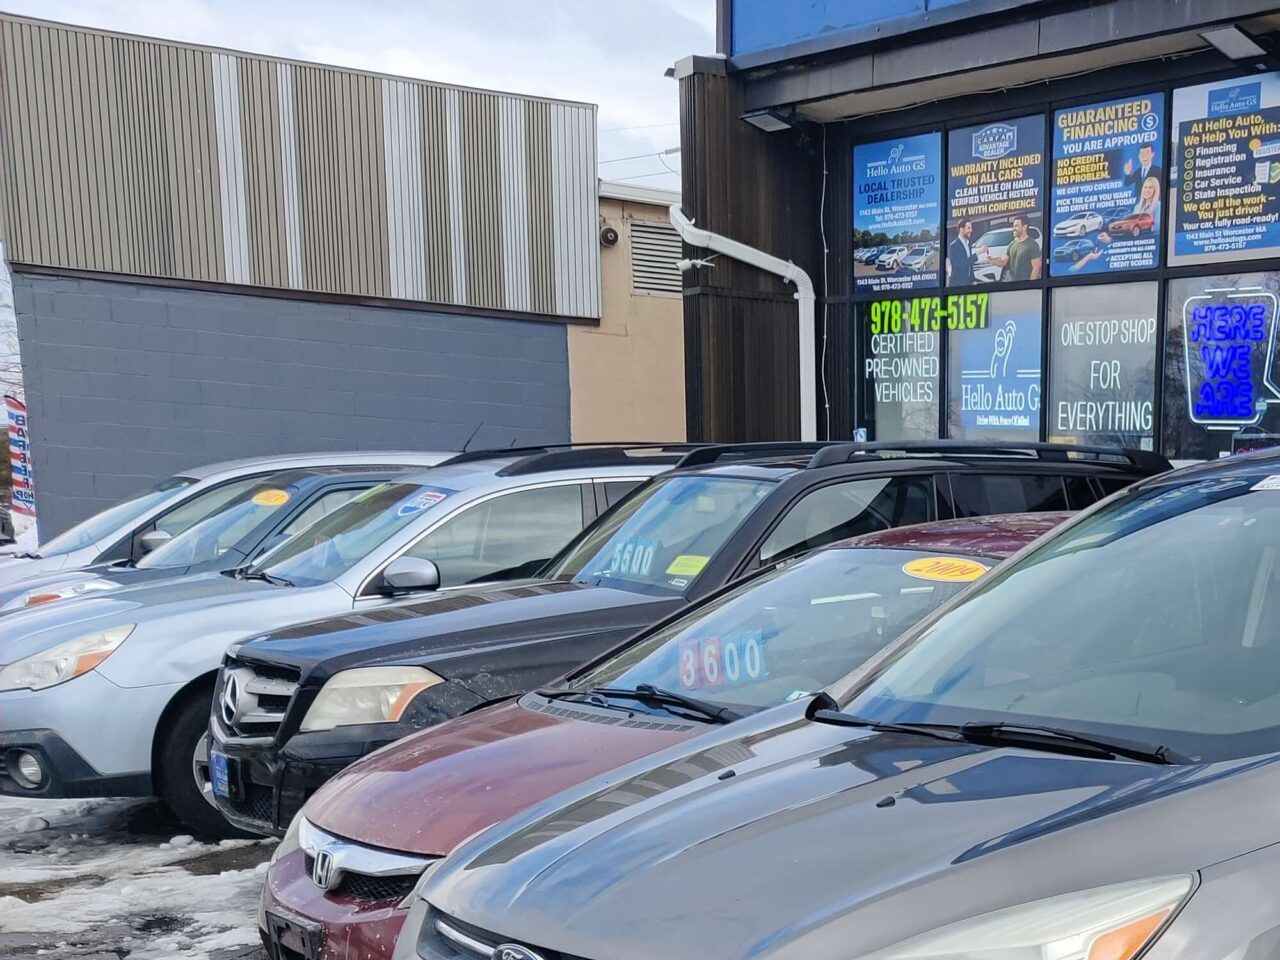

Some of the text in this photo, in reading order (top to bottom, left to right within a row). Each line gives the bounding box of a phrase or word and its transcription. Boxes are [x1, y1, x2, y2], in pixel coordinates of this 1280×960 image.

[1058, 100, 1152, 128] GUARANTEED
[1191, 114, 1265, 134] At Hello Auto,
[1063, 116, 1138, 142] FINANCING
[1183, 123, 1280, 147] We Help You With:
[1063, 131, 1158, 155] YOU ARE APPROVED
[1196, 143, 1237, 156] Financing
[866, 160, 926, 178] Hello Auto GS
[951, 154, 1041, 177] WARRANTY INCLUDED
[1057, 154, 1105, 168] NO CREDIT?
[1057, 161, 1109, 177] BAD CREDIT?
[1195, 153, 1247, 168] Registration
[966, 168, 1023, 186] ON ALL CARS
[1057, 170, 1110, 185] NO PROBLEM.
[1195, 166, 1237, 178] Insurance
[858, 174, 935, 195] LOCAL TRUSTED
[955, 179, 1034, 197] CLEAN TITLE ON HAND
[1056, 181, 1123, 196] WE GOT YOU COVERED
[1194, 176, 1243, 189] Car Service
[1194, 184, 1262, 200] State Inspection
[867, 187, 925, 205] DEALERSHIP
[951, 187, 1039, 207] VERIFIED VEHICLE HISTORY
[1056, 190, 1132, 207] PICK THE CAR YOU WANT
[1056, 205, 1070, 213] AND
[1070, 203, 1089, 212] DRIVE
[1096, 200, 1116, 208] HOME
[1116, 197, 1137, 206] TODAY
[1183, 194, 1267, 212] We do all the work
[952, 198, 1036, 218] BUY WITH CONFIDENCE
[1197, 204, 1263, 220] You just drive!
[1183, 212, 1279, 231] Your car, fully road-ready!
[1199, 231, 1214, 239] Main
[1222, 227, 1255, 236] Worcester
[1110, 251, 1154, 262] ACCEPTING ALL
[1130, 259, 1153, 267] SCORES
[871, 292, 989, 334] 978-473-5157
[1061, 318, 1156, 346] ONE STOP SHOP
[1191, 305, 1266, 342] HERE
[871, 331, 934, 355] CERTIFIED
[865, 356, 938, 379] PRE-OWNED
[1201, 344, 1252, 381] WE
[1090, 359, 1121, 390] FOR
[875, 381, 933, 403] VEHICLES
[961, 384, 1041, 411] Hello Auto G
[1195, 381, 1254, 417] ARE
[1057, 400, 1152, 431] EVERYTHING
[611, 543, 654, 575] 5500
[682, 639, 761, 687] 3600
